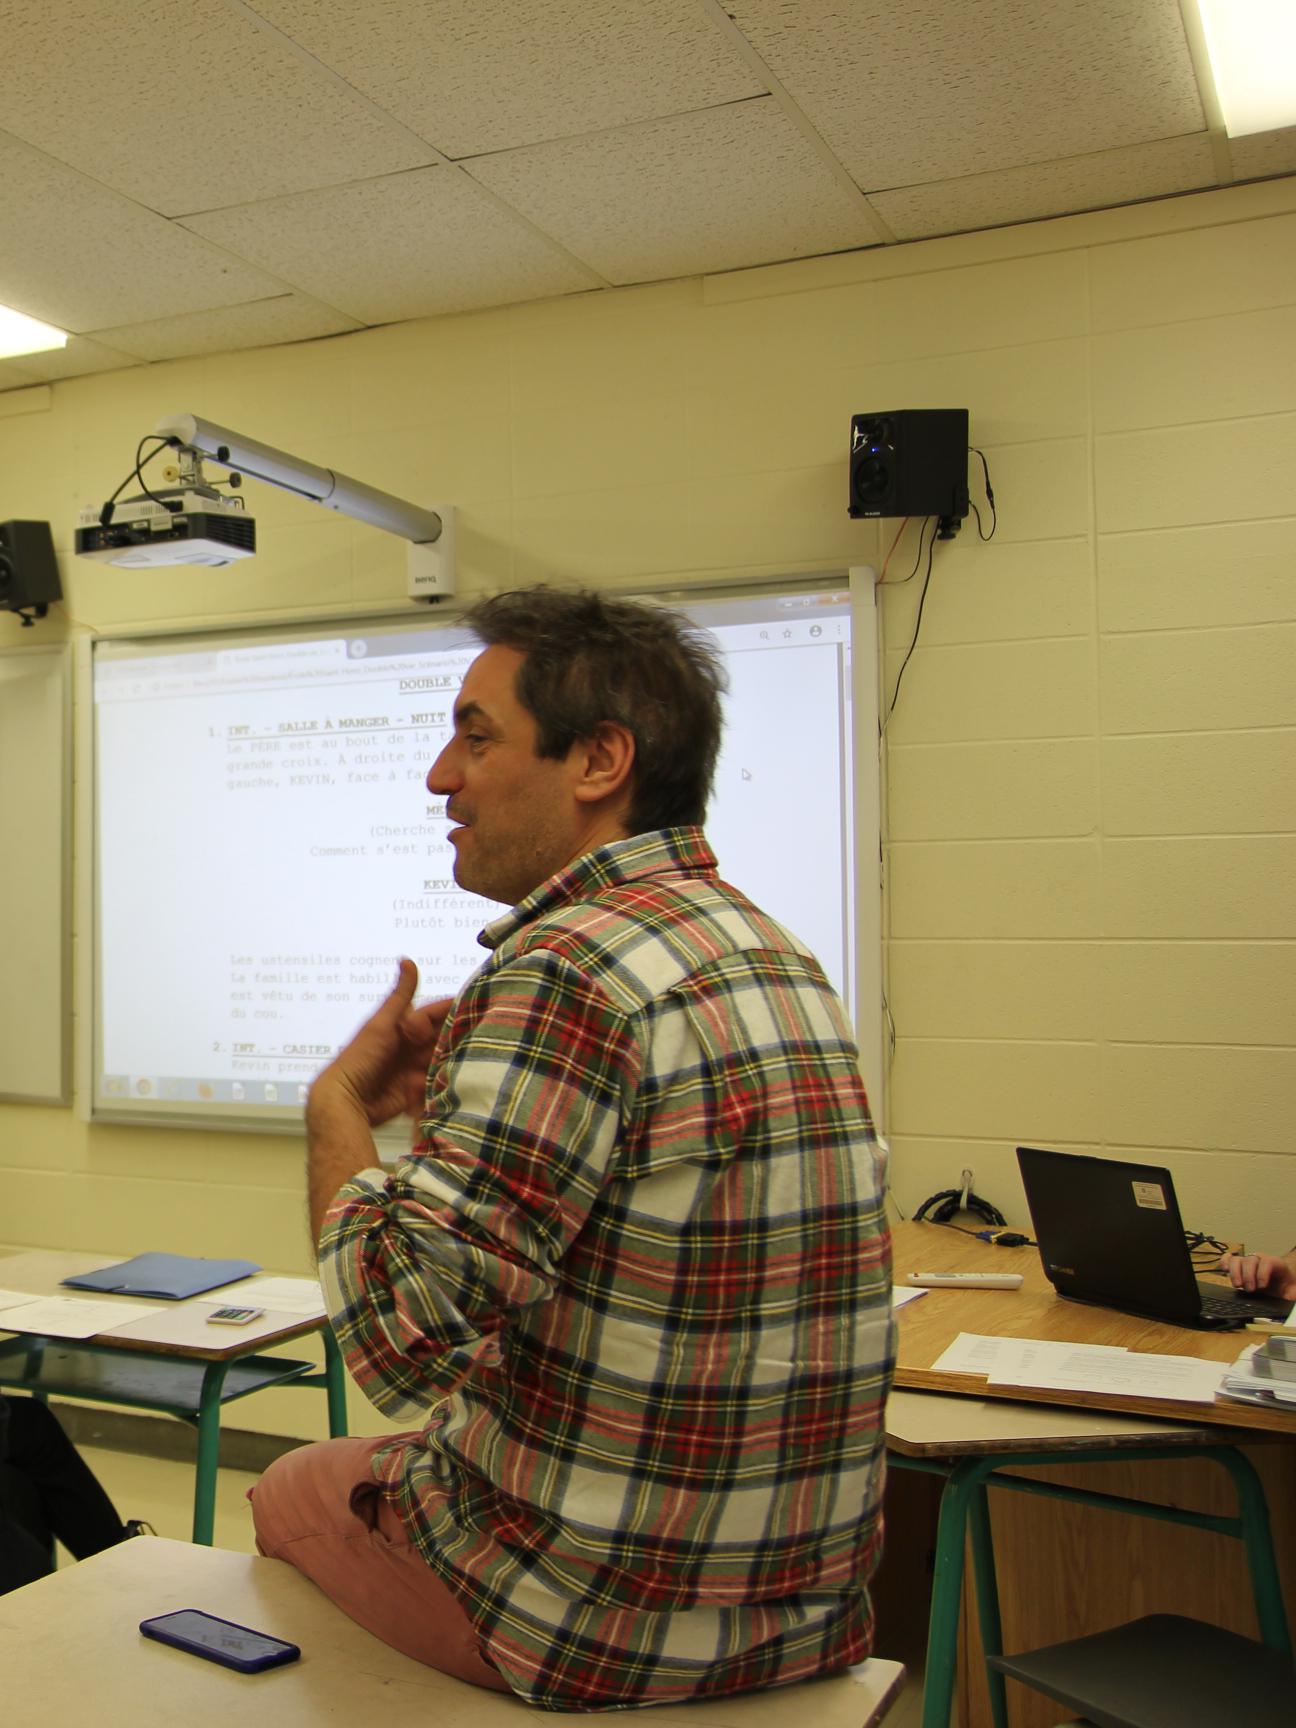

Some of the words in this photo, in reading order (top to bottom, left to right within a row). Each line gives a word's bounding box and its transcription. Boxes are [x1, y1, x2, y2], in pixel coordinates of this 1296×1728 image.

[399, 677, 451, 690] DOUBLE
[227, 724, 256, 736] INT.
[278, 720, 318, 733] SALLE
[338, 716, 390, 729] MANGER
[410, 712, 447, 724] NUIT
[288, 740, 312, 751] est
[321, 738, 337, 749] au
[345, 735, 377, 747] bout
[386, 732, 404, 744] de
[415, 731, 431, 742] la
[226, 758, 273, 774] grande
[281, 756, 329, 769] croix.
[354, 750, 405, 765] droite
[413, 748, 430, 761] du
[226, 776, 280, 791] gauche,
[290, 772, 336, 786] KEVIN,
[347, 770, 380, 783] face
[369, 823, 434, 839] (Cherche
[310, 844, 368, 857] Comment
[392, 896, 501, 911] (Indifférent)
[395, 915, 447, 929] Plutôt
[230, 953, 254, 966] Les
[261, 952, 342, 966] ustensiles
[417, 954, 441, 966] sur
[452, 953, 477, 966] les
[230, 971, 247, 984] La
[254, 970, 309, 984] famille
[316, 972, 342, 984] est
[424, 973, 461, 985] avec
[230, 990, 255, 1002] est
[261, 988, 294, 1002] vêtu
[301, 989, 318, 1002] de
[325, 991, 351, 1003] son
[230, 1007, 247, 1019] du
[253, 1008, 284, 1019] cou.
[212, 1041, 226, 1053] 2.
[233, 1042, 261, 1054] INT.
[282, 1044, 331, 1055] CASIER
[233, 1058, 270, 1073] Kevin
